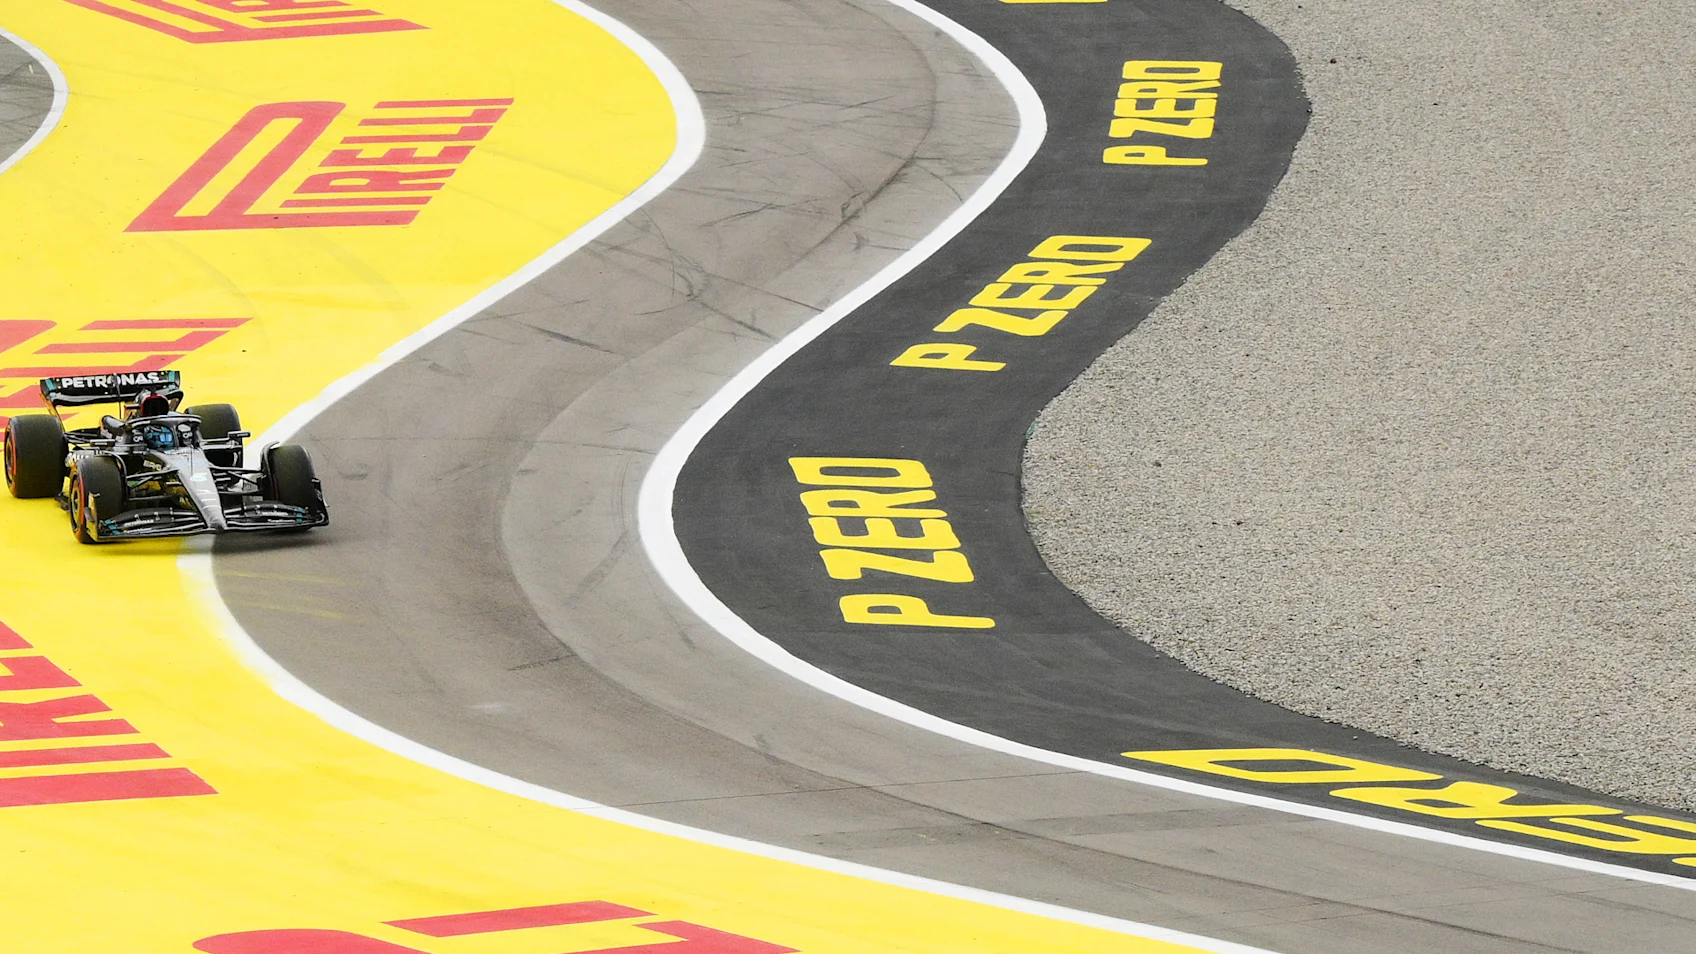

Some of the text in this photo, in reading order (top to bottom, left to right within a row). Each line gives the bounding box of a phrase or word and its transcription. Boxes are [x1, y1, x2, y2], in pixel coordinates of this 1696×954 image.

[122, 98, 514, 233] PIRELLI
[1102, 60, 1223, 166] P ZERO
[889, 235, 1152, 371] P ZERO
[61, 372, 159, 388] PETRONAS
[788, 457, 996, 629] P ZERO
[1121, 748, 1696, 868] ERO
